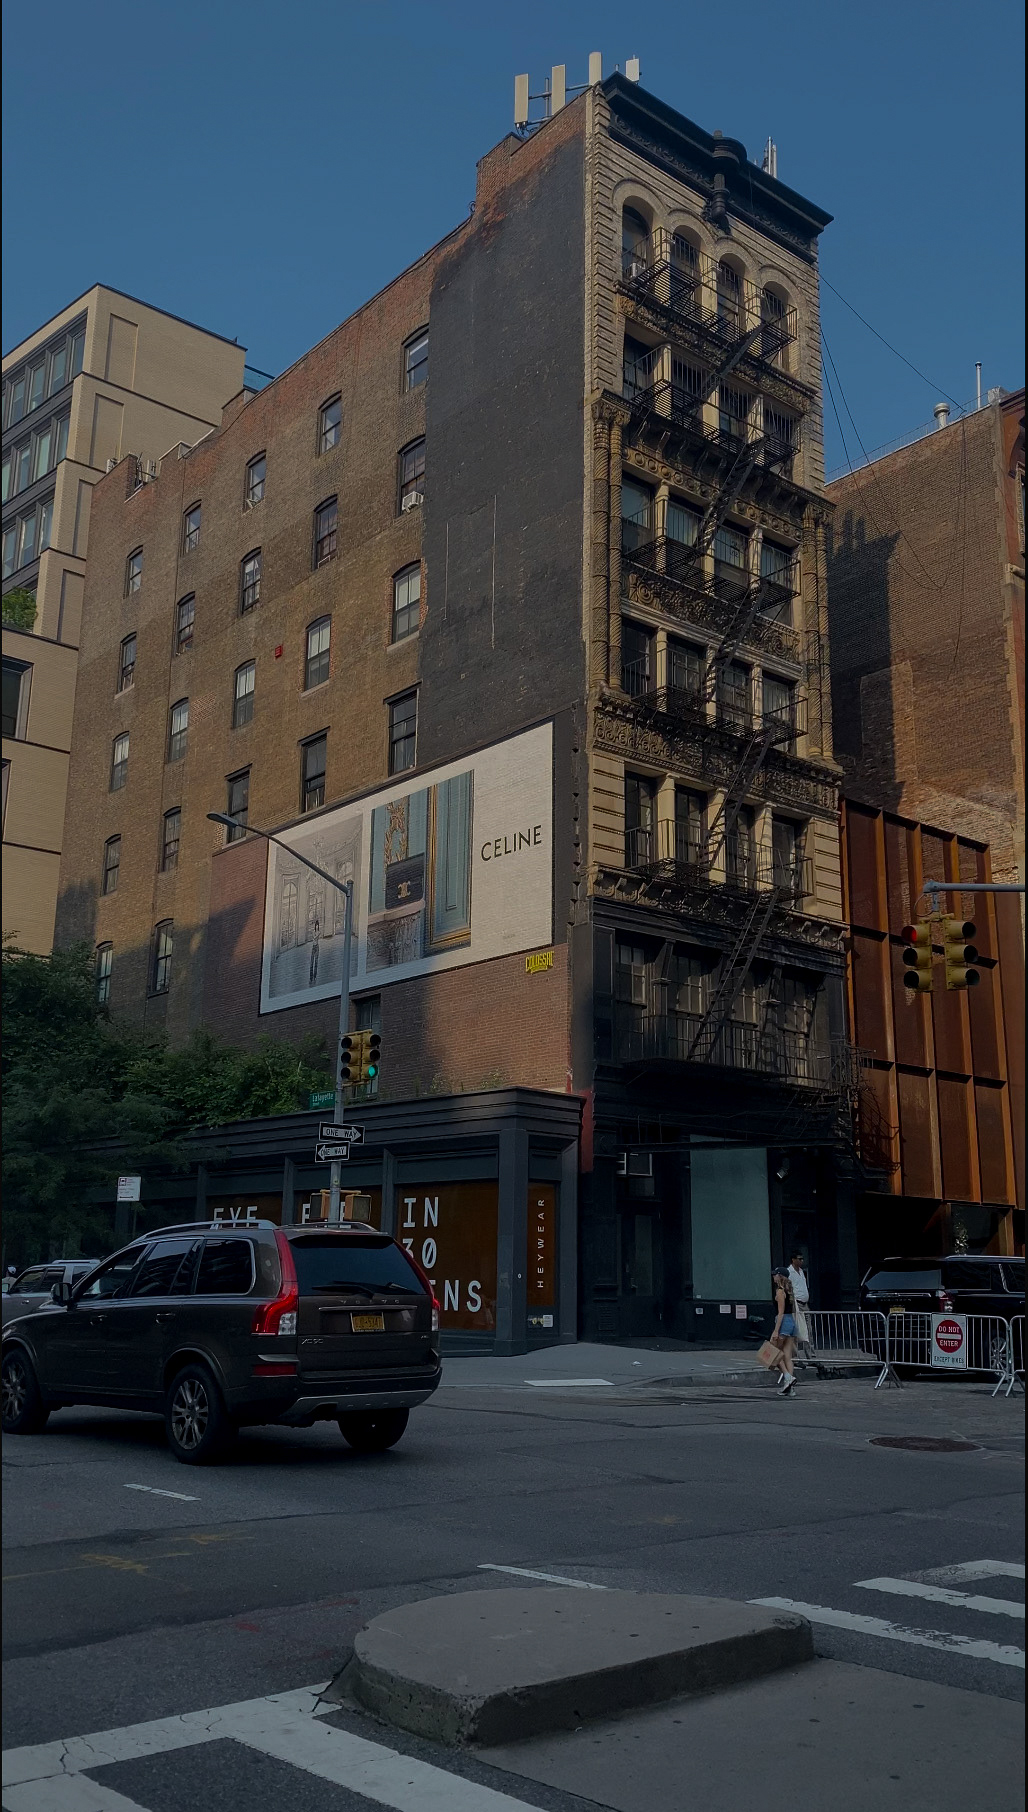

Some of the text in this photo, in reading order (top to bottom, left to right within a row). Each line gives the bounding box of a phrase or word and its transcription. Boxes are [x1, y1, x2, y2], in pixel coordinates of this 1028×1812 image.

[481, 825, 542, 861] CELINE
[312, 1092, 334, 1103] Lafayette
[325, 1128, 358, 1138] ONE WAY
[320, 1147, 345, 1156] ONE WAY
[403, 1197, 439, 1228] IN
[537, 1199, 545, 1289] HEYWEAR
[938, 1325, 946, 1333] DO
[939, 1339, 959, 1347] ENTER
[933, 1355, 965, 1364] EXCEPT BIKES
